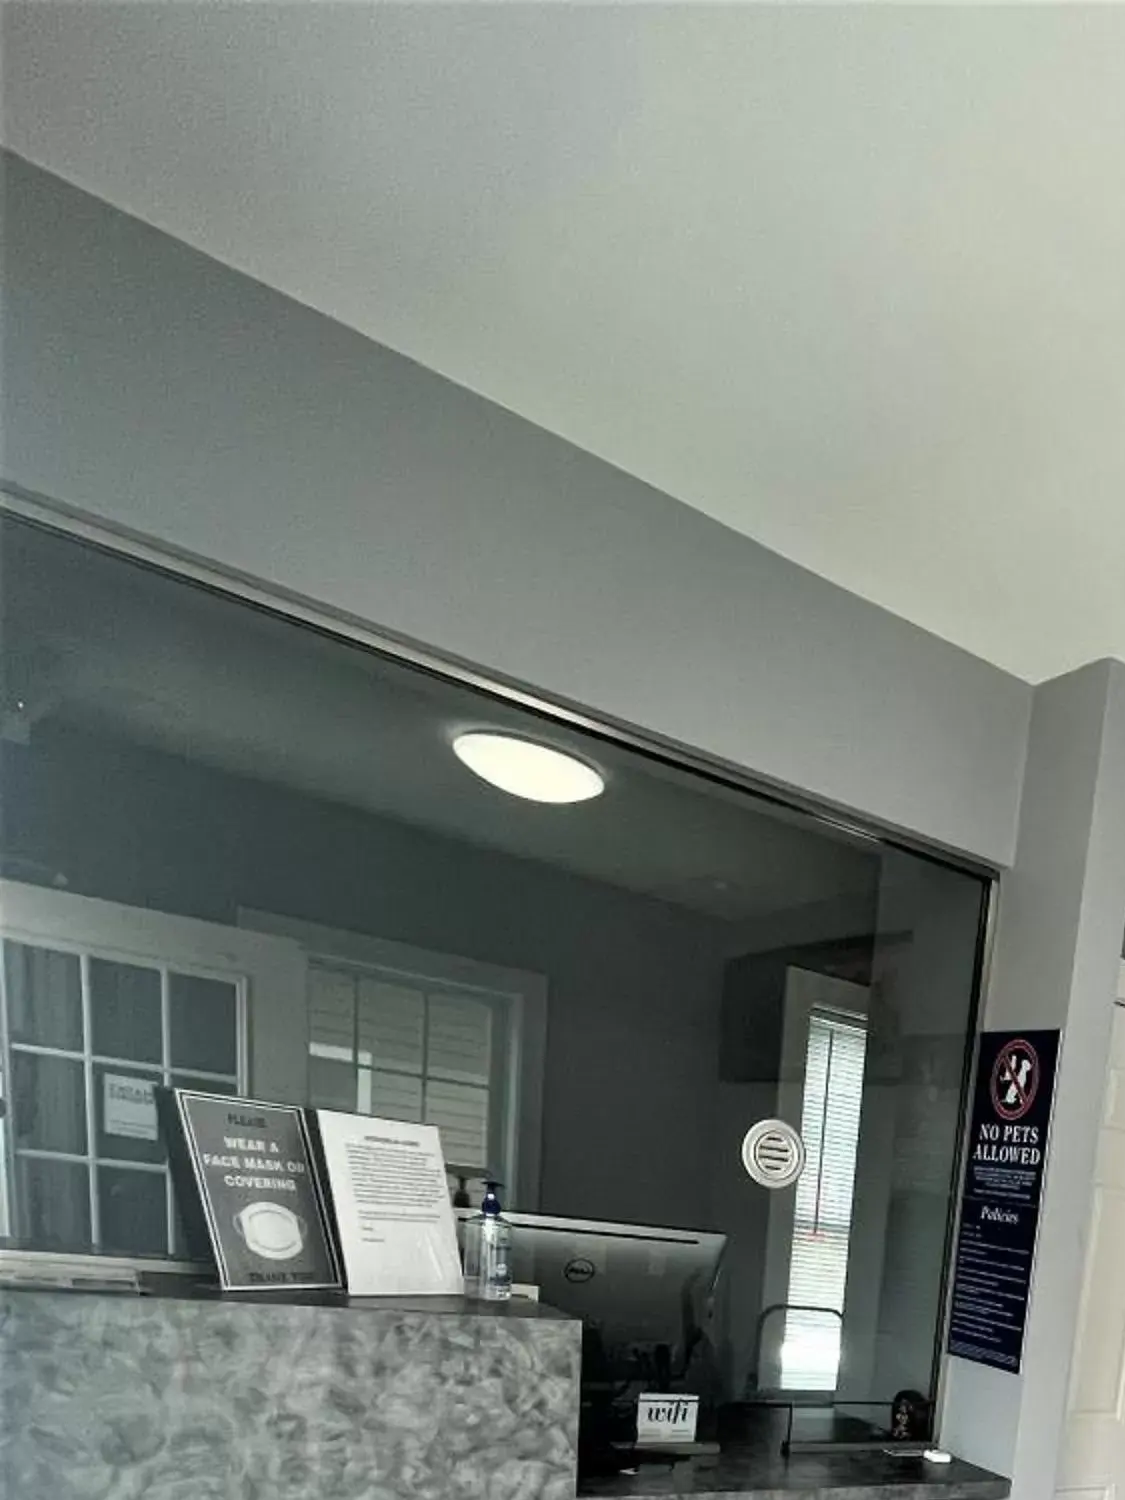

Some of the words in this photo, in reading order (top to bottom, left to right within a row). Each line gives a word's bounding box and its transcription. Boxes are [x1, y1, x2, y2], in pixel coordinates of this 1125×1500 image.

[980, 1123, 1000, 1141] NO
[1003, 1125, 1039, 1144] PETS
[224, 1136, 265, 1152] WEAR
[269, 1141, 279, 1153] A
[972, 1143, 1041, 1165] ALLOWED
[203, 1153, 240, 1169] FACE
[244, 1157, 284, 1172] MASK
[223, 1175, 296, 1192] COVERING
[647, 1401, 690, 1425] wifi
